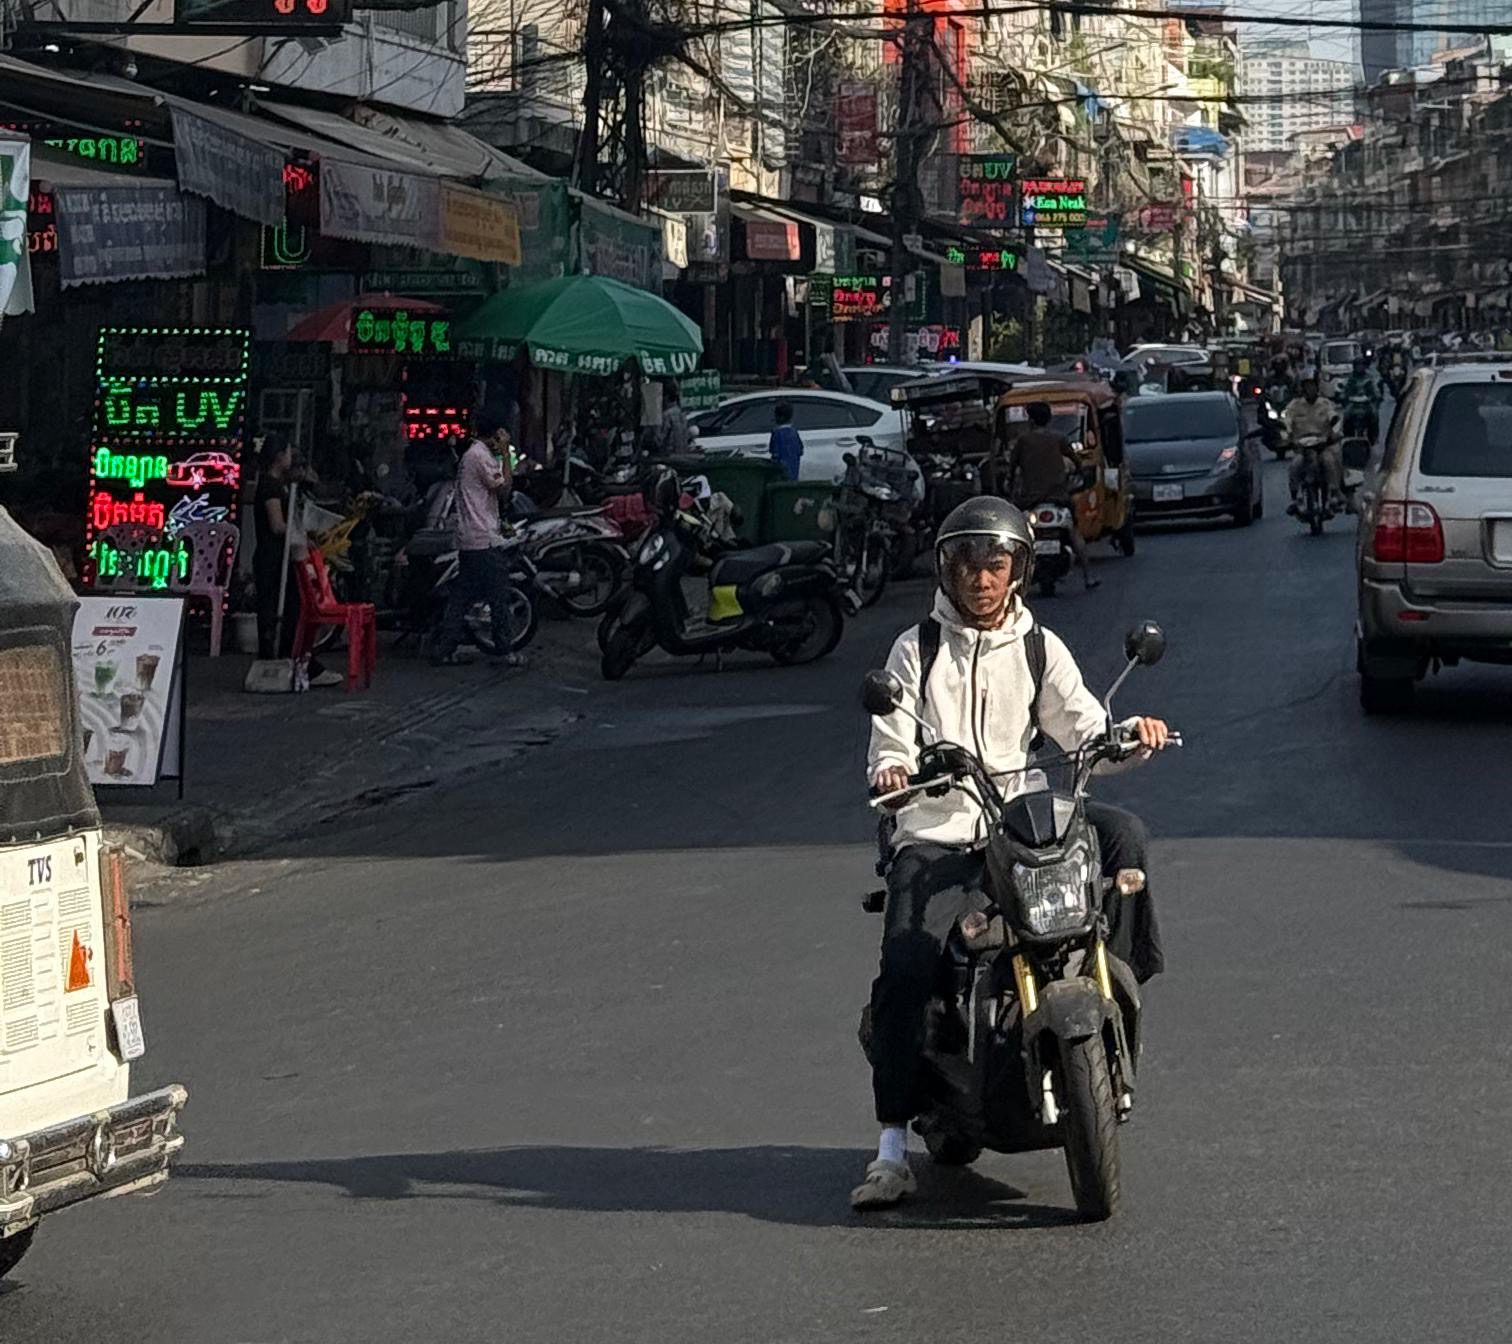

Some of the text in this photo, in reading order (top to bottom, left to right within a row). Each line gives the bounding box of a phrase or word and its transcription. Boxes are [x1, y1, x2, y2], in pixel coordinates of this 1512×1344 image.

[670, 352, 697, 374] UV
[176, 391, 241, 429] UV
[28, 854, 52, 886] TVS
